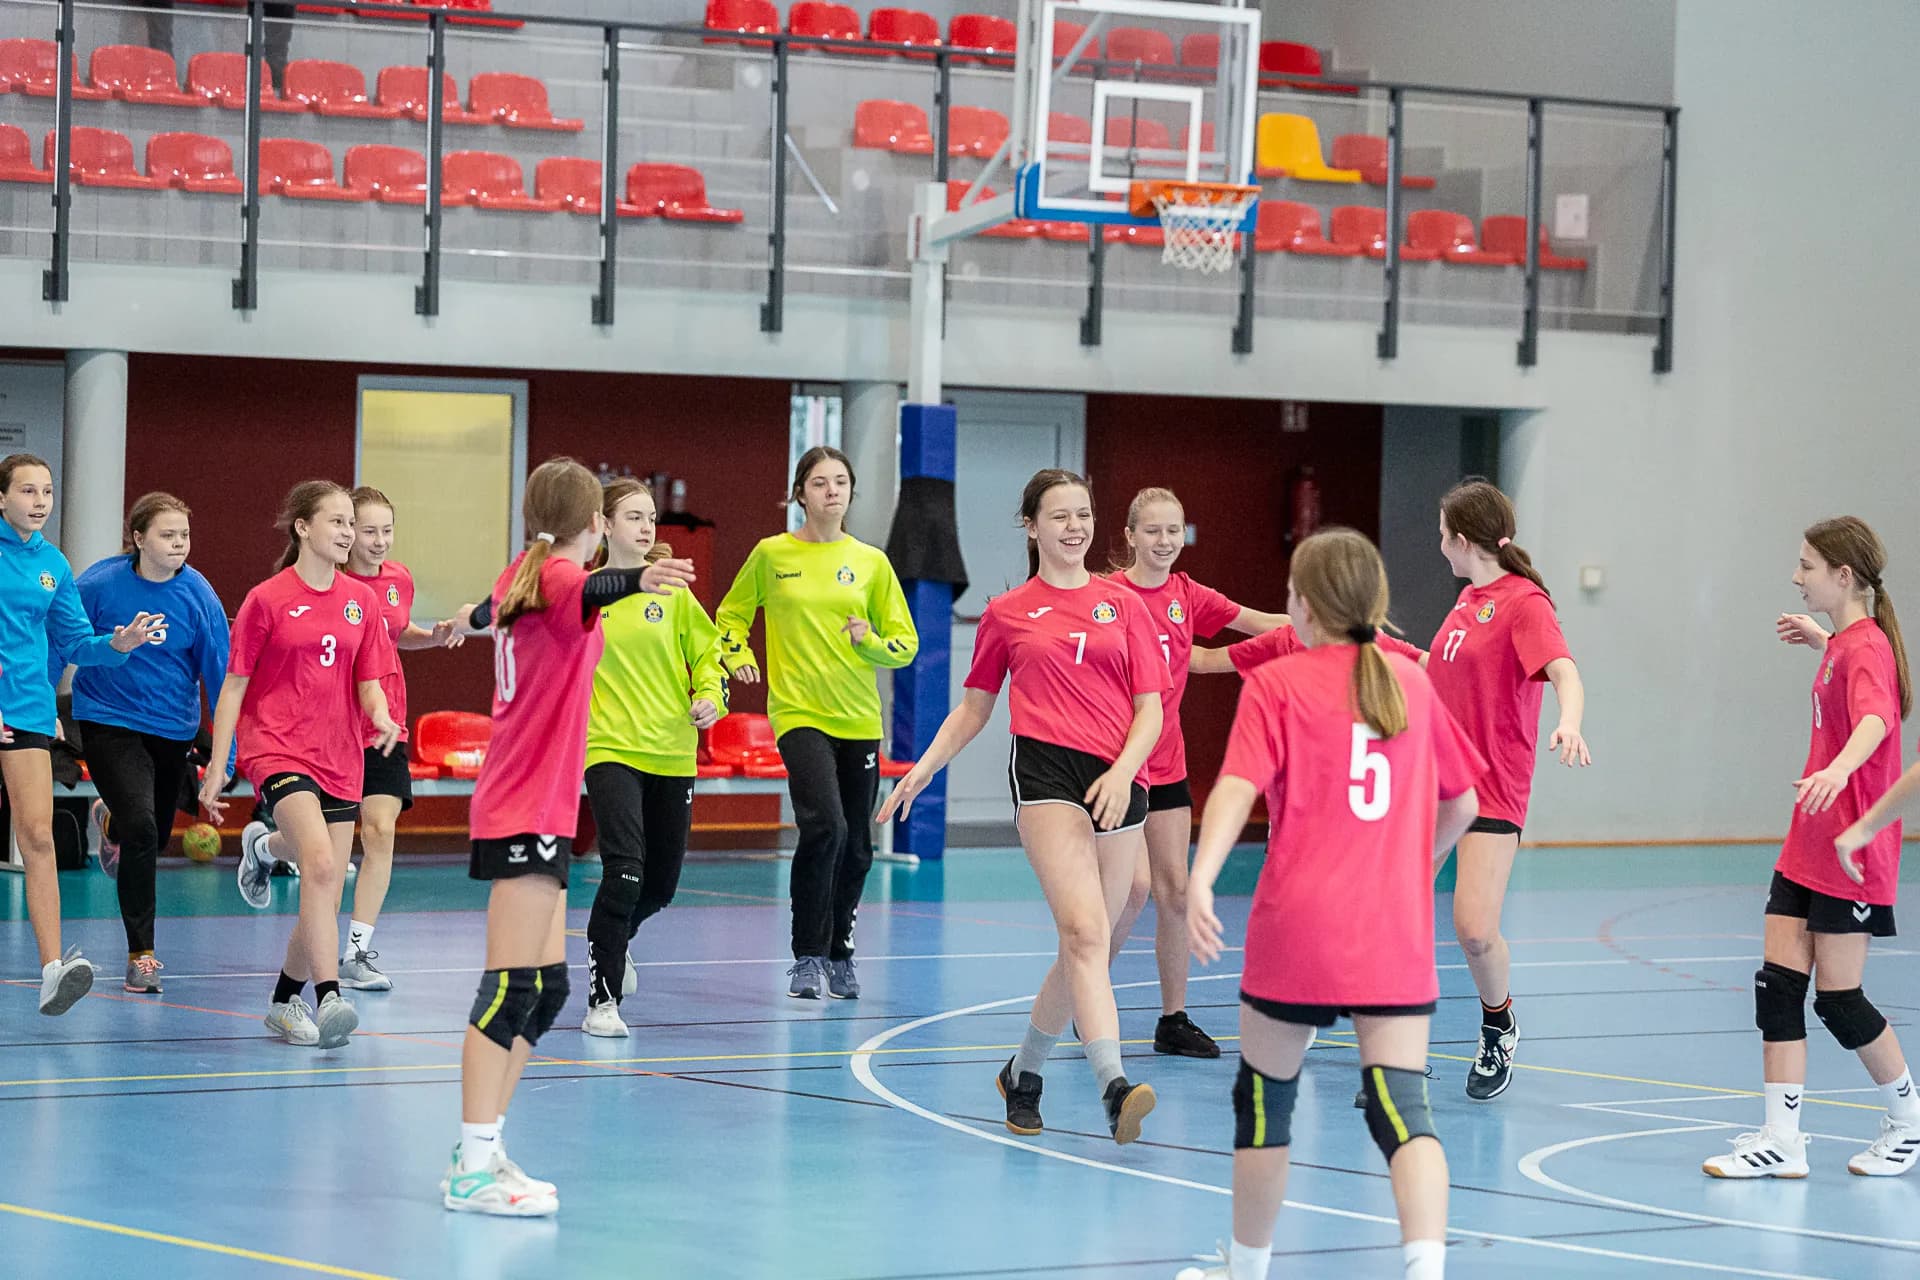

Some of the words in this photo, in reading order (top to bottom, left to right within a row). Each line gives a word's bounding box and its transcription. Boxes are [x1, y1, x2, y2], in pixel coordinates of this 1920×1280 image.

[319, 634, 337, 667] 3
[1068, 631, 1087, 665] 7
[1443, 629, 1468, 663] 17
[1348, 721, 1391, 822] 5
